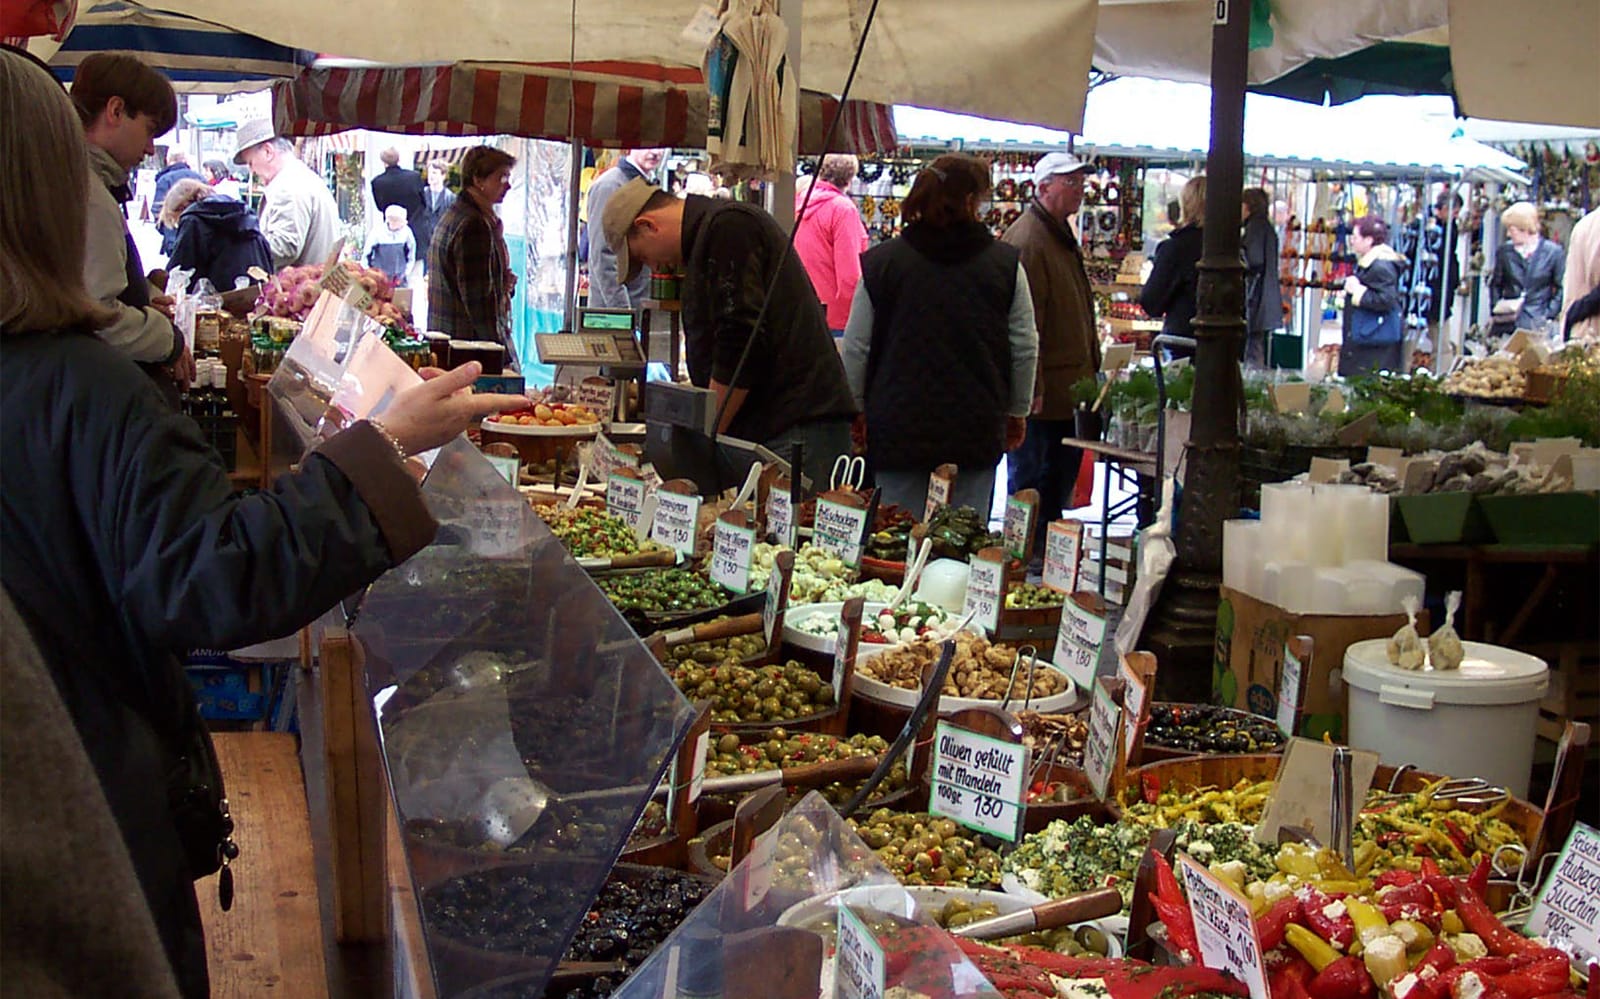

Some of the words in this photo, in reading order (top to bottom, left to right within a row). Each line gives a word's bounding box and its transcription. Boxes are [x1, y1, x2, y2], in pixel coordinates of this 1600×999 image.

[940, 735, 972, 763] Oliven
[973, 747, 1015, 775] gefüllt
[938, 762, 954, 781] mit
[955, 766, 1002, 796] Mandeln
